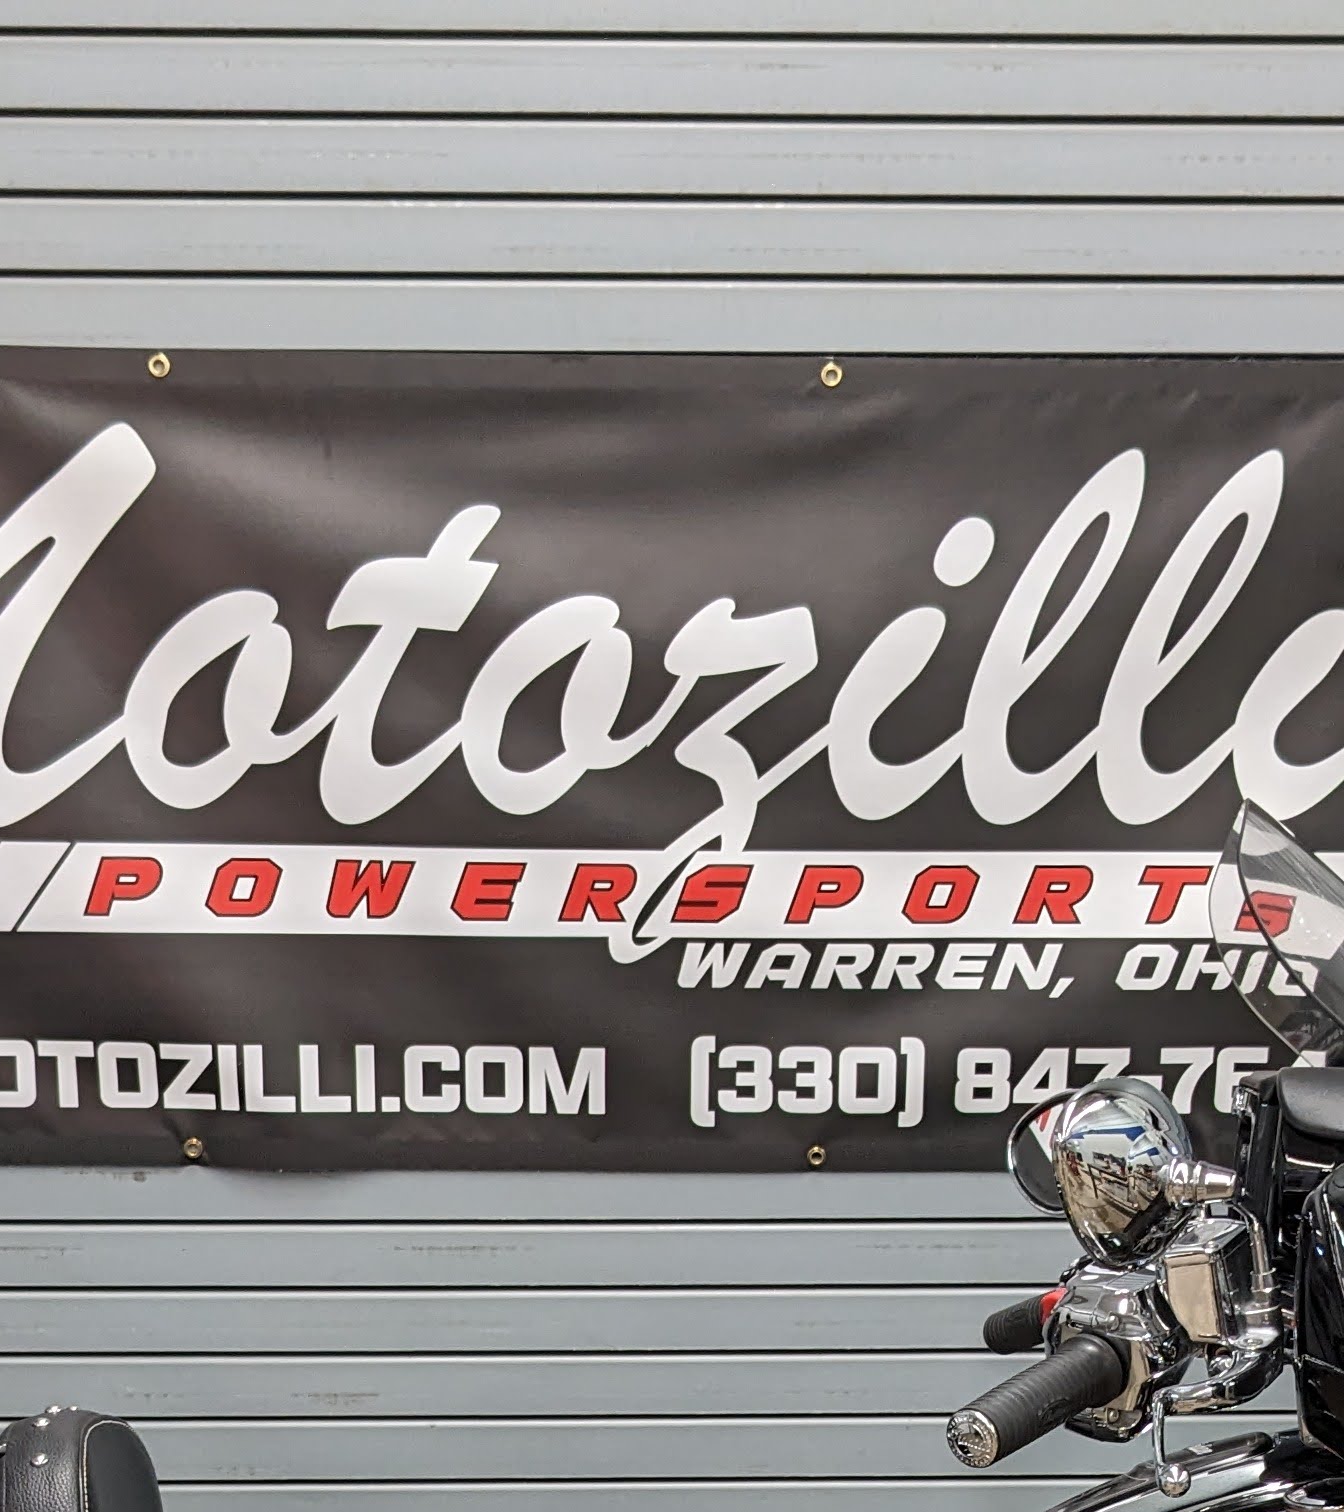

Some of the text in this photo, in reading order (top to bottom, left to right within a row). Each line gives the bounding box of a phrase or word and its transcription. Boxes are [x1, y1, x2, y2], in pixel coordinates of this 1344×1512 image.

[84, 857, 1296, 939] POWERSPORTS
[677, 942, 1320, 999] WARREN, OHIO
[690, 1035, 926, 1129] (330)
